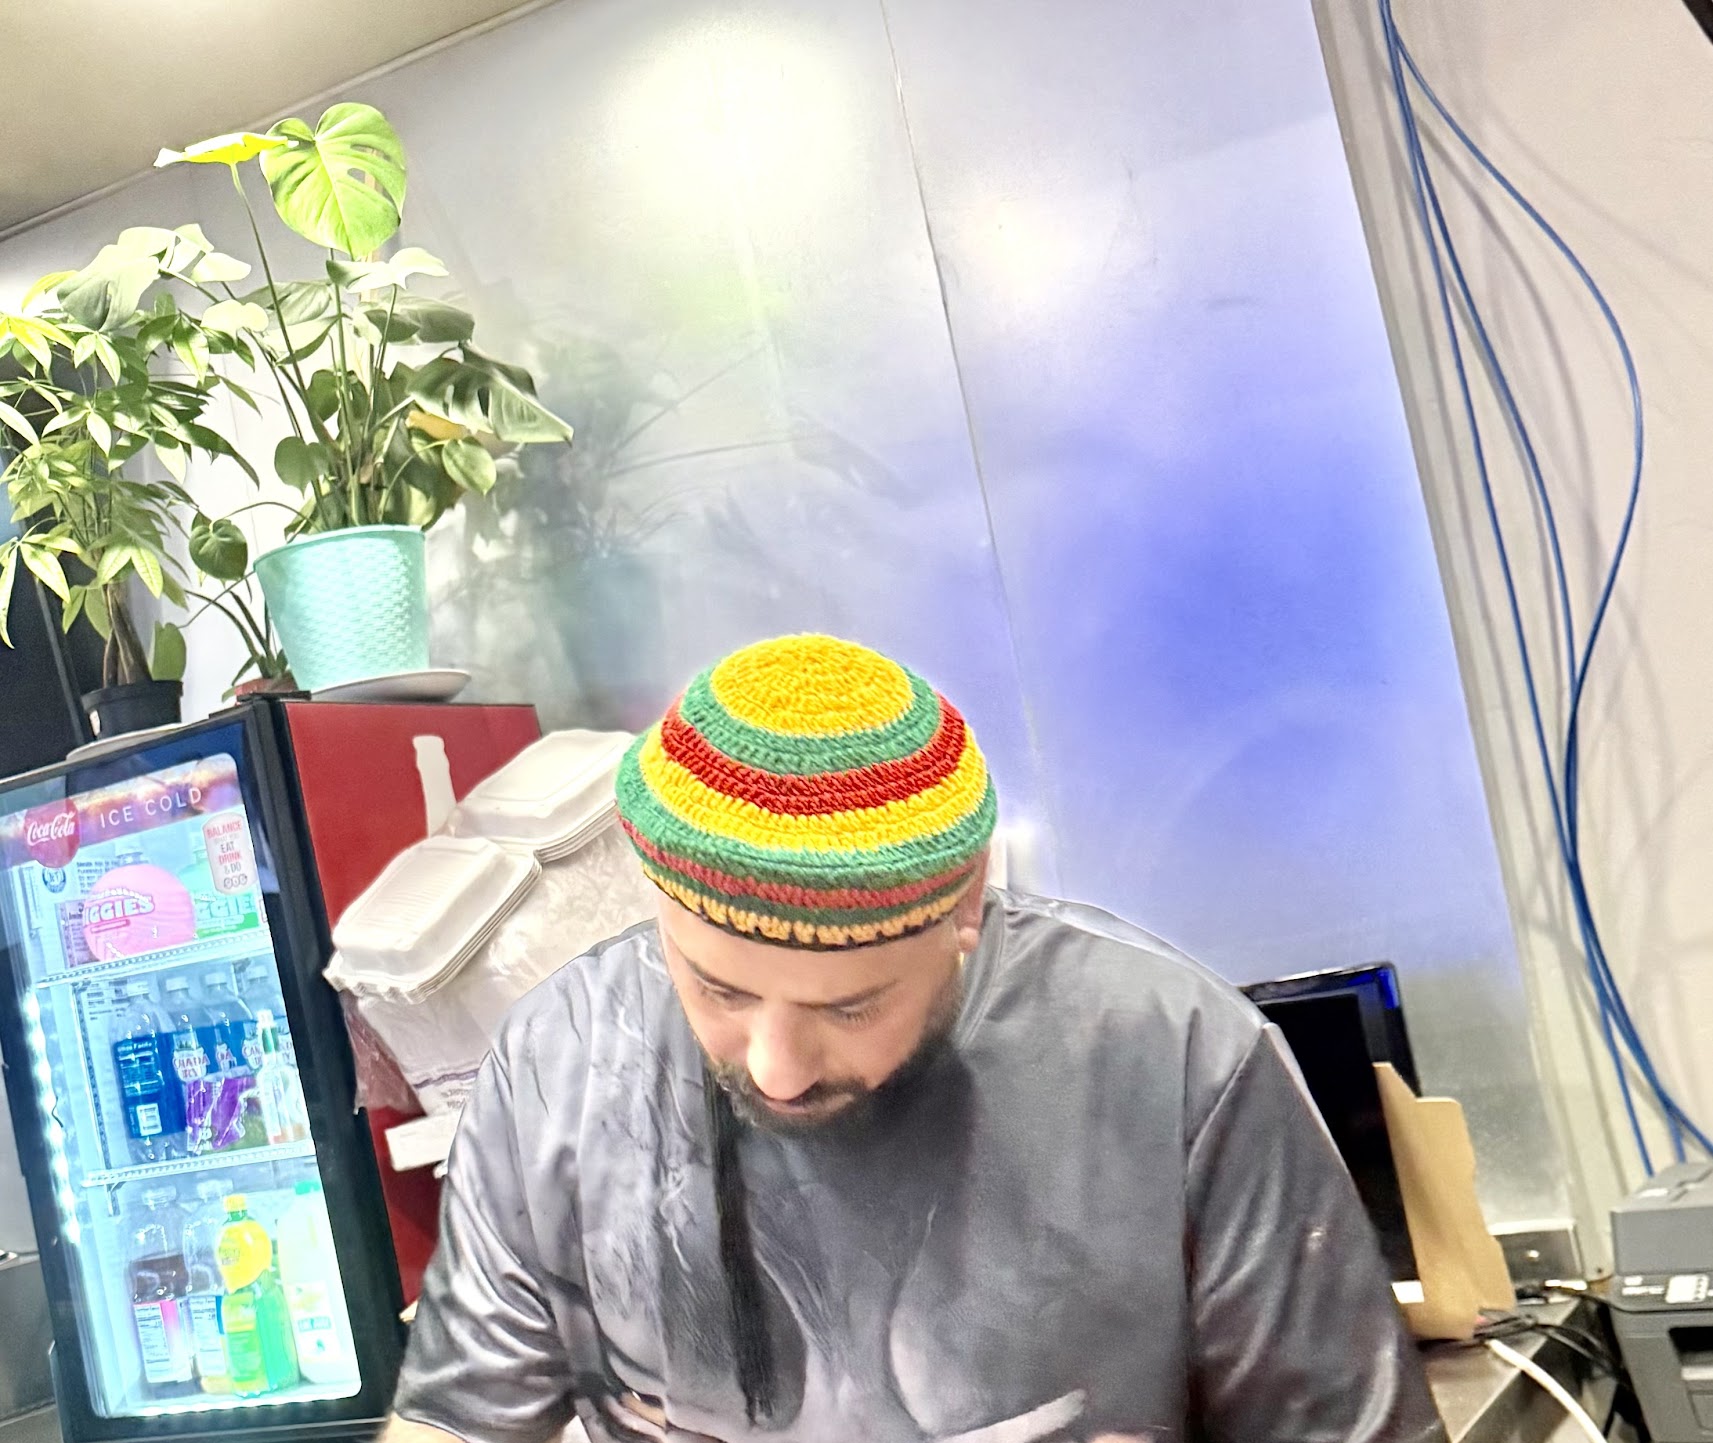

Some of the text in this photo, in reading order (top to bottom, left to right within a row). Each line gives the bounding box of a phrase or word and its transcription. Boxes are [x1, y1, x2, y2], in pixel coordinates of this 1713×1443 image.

[100, 787, 202, 829] ICE COLD
[206, 820, 243, 839] BALANCE
[220, 841, 235, 853] EAT
[218, 852, 242, 865] DRINK
[231, 862, 242, 873] DO
